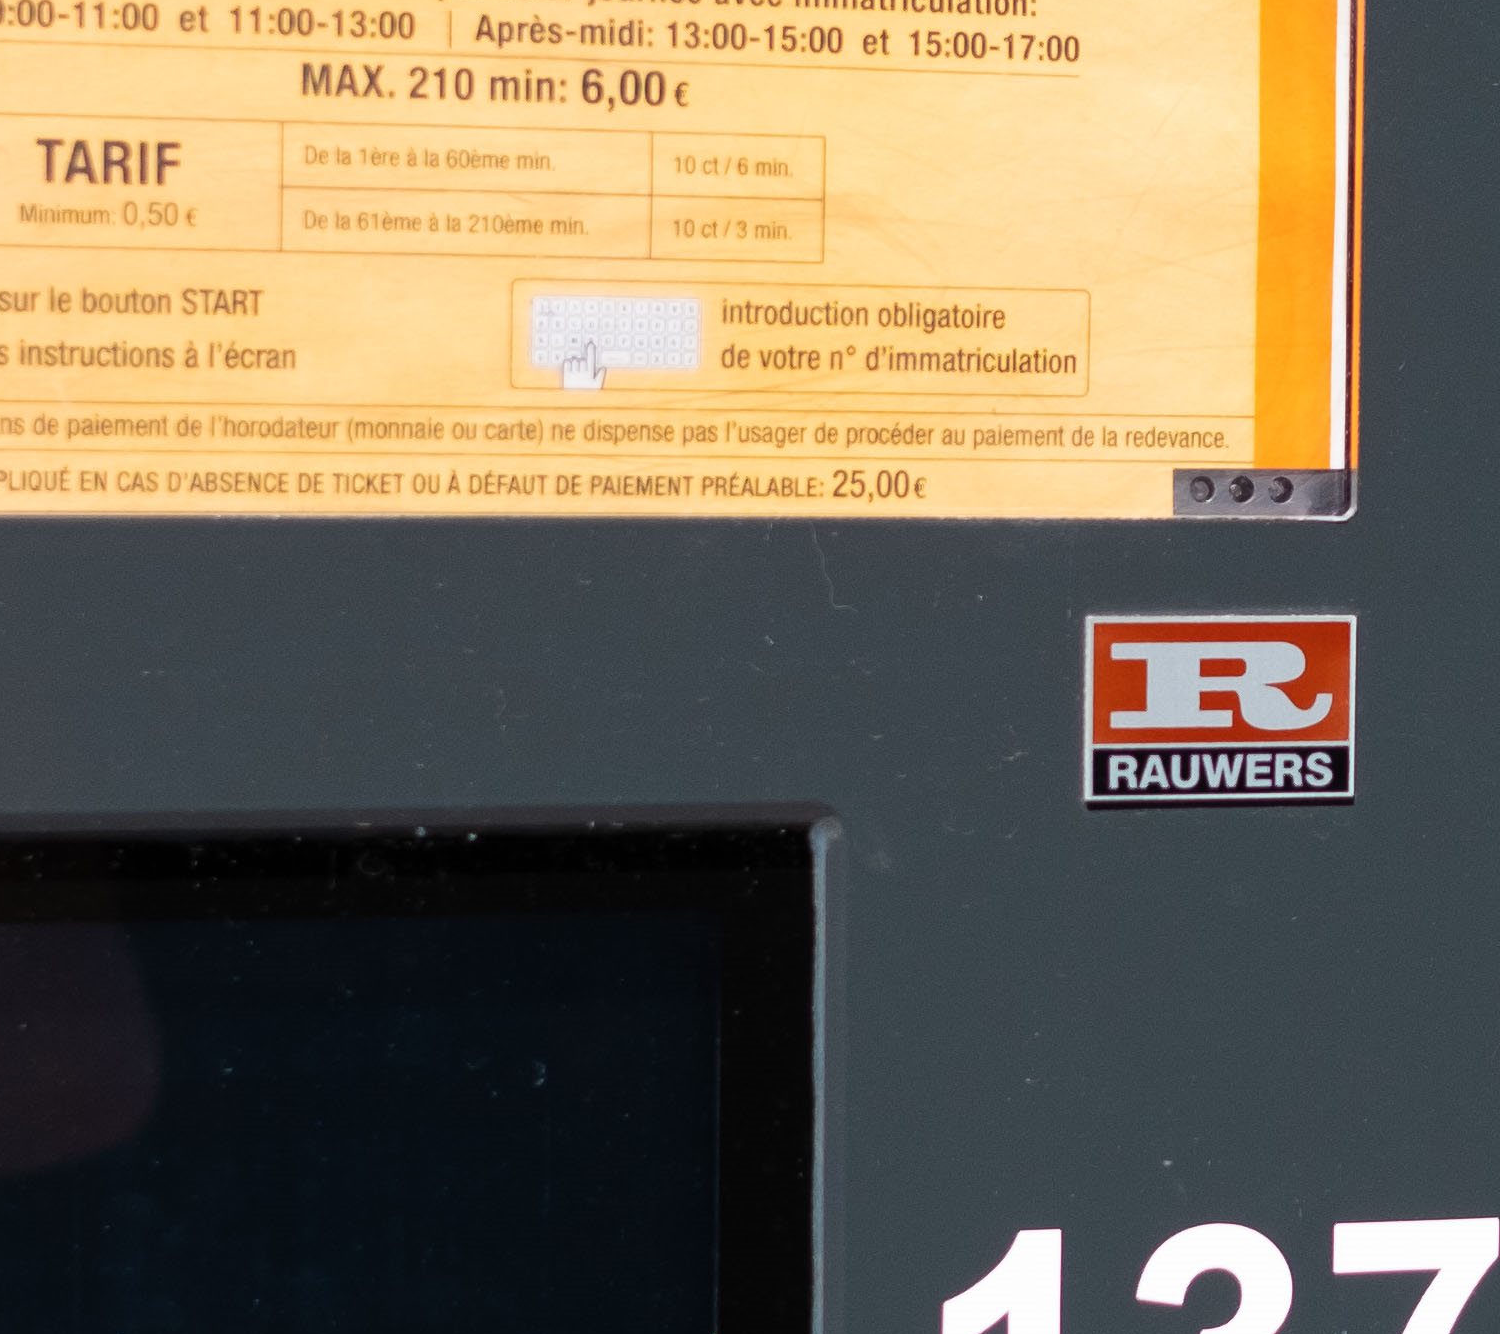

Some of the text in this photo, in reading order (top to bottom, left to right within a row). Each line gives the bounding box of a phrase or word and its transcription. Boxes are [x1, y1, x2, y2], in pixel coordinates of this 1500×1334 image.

[179, 6, 210, 34] et
[230, 6, 415, 40] 11:00-13:00
[475, 13, 1081, 63] Après-midi: 13:00-15:00 et 15:00-17:00
[300, 62, 396, 99] MAX.
[409, 67, 475, 101] 210
[488, 71, 568, 104] min:
[36, 137, 181, 186] TARIF
[304, 145, 556, 172] De la 1ère à la 60ème min.
[673, 155, 697, 177] 10
[701, 156, 719, 178] ct
[736, 157, 749, 178] 6
[755, 157, 794, 179] min.
[303, 209, 590, 237] De la 61ème à la 210ème min.
[673, 219, 697, 240] 10
[701, 219, 719, 240] ct
[736, 220, 748, 242] 3
[754, 221, 793, 242] min.
[49, 286, 73, 315] le
[81, 288, 171, 315] bouton
[181, 289, 264, 317] START
[721, 298, 870, 328] introduction
[877, 301, 1007, 335] obligatoire
[19, 342, 175, 369] instructions
[184, 343, 200, 369] à
[208, 342, 297, 370] l'écran
[721, 345, 750, 370] de
[758, 347, 822, 371] votre
[864, 344, 1078, 375] d'immatriculation
[34, 413, 60, 437] de
[66, 414, 168, 442] paiement
[176, 415, 202, 439] de
[211, 415, 338, 441] l'horodateur
[346, 417, 445, 443] (monnaie
[452, 423, 478, 442] ou
[483, 419, 543, 445] carte)
[551, 424, 576, 443] ne
[583, 419, 676, 449] dispense
[682, 427, 719, 450] pas
[726, 420, 808, 452] l'usager
[814, 423, 839, 446] de
[846, 423, 934, 452] procéder
[941, 428, 966, 448] au
[973, 425, 1065, 454] paiement
[1072, 425, 1096, 449] de
[1101, 426, 1118, 450] la
[1125, 426, 1230, 451] redevance.
[80, 469, 108, 492] EN
[117, 470, 159, 493] CAS
[167, 471, 289, 494] D'ABSENCE
[298, 472, 324, 494] DE
[332, 472, 405, 495] TICKET
[412, 473, 440, 496] OU
[447, 469, 462, 496] À
[468, 469, 549, 497] DÉFAUT
[555, 474, 582, 497] DE
[590, 474, 694, 498] PAIEMENT
[701, 470, 825, 499] PRÉALABLE:
[1110, 641, 1333, 731] R
[1108, 752, 1333, 790] RAUWERS
